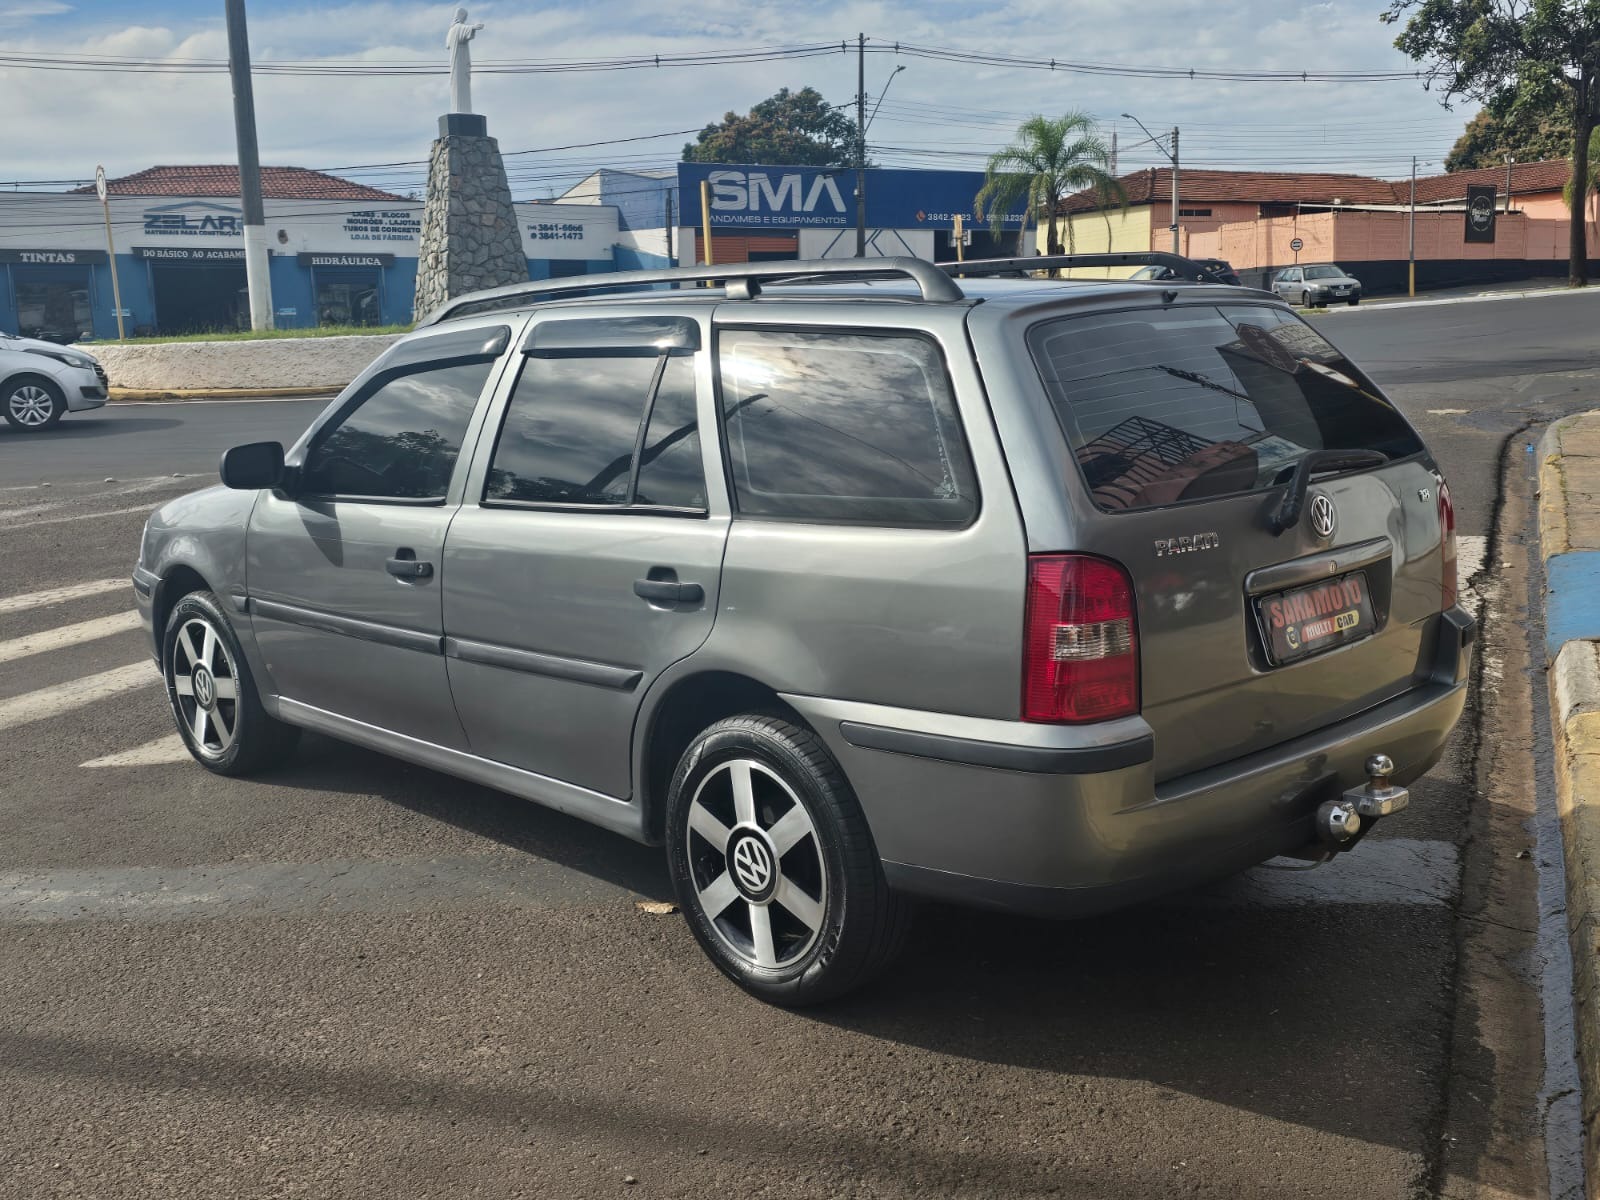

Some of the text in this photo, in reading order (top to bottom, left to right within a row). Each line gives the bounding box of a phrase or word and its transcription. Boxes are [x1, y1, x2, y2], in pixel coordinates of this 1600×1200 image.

[143, 214, 236, 230] ZELAR
[709, 215, 847, 224] ANDAIMES E EQUIPAMENTOS
[927, 213, 971, 221] 3842.223
[382, 233, 414, 241] FÁBRICA
[20, 252, 76, 264] TINTAS
[142, 248, 247, 259] DO BÁSICO AO ACABAME
[312, 256, 382, 266] HIDRÁULICA
[1270, 579, 1362, 628] SAKAMOTO
[1305, 613, 1355, 640] MULTI CAR
